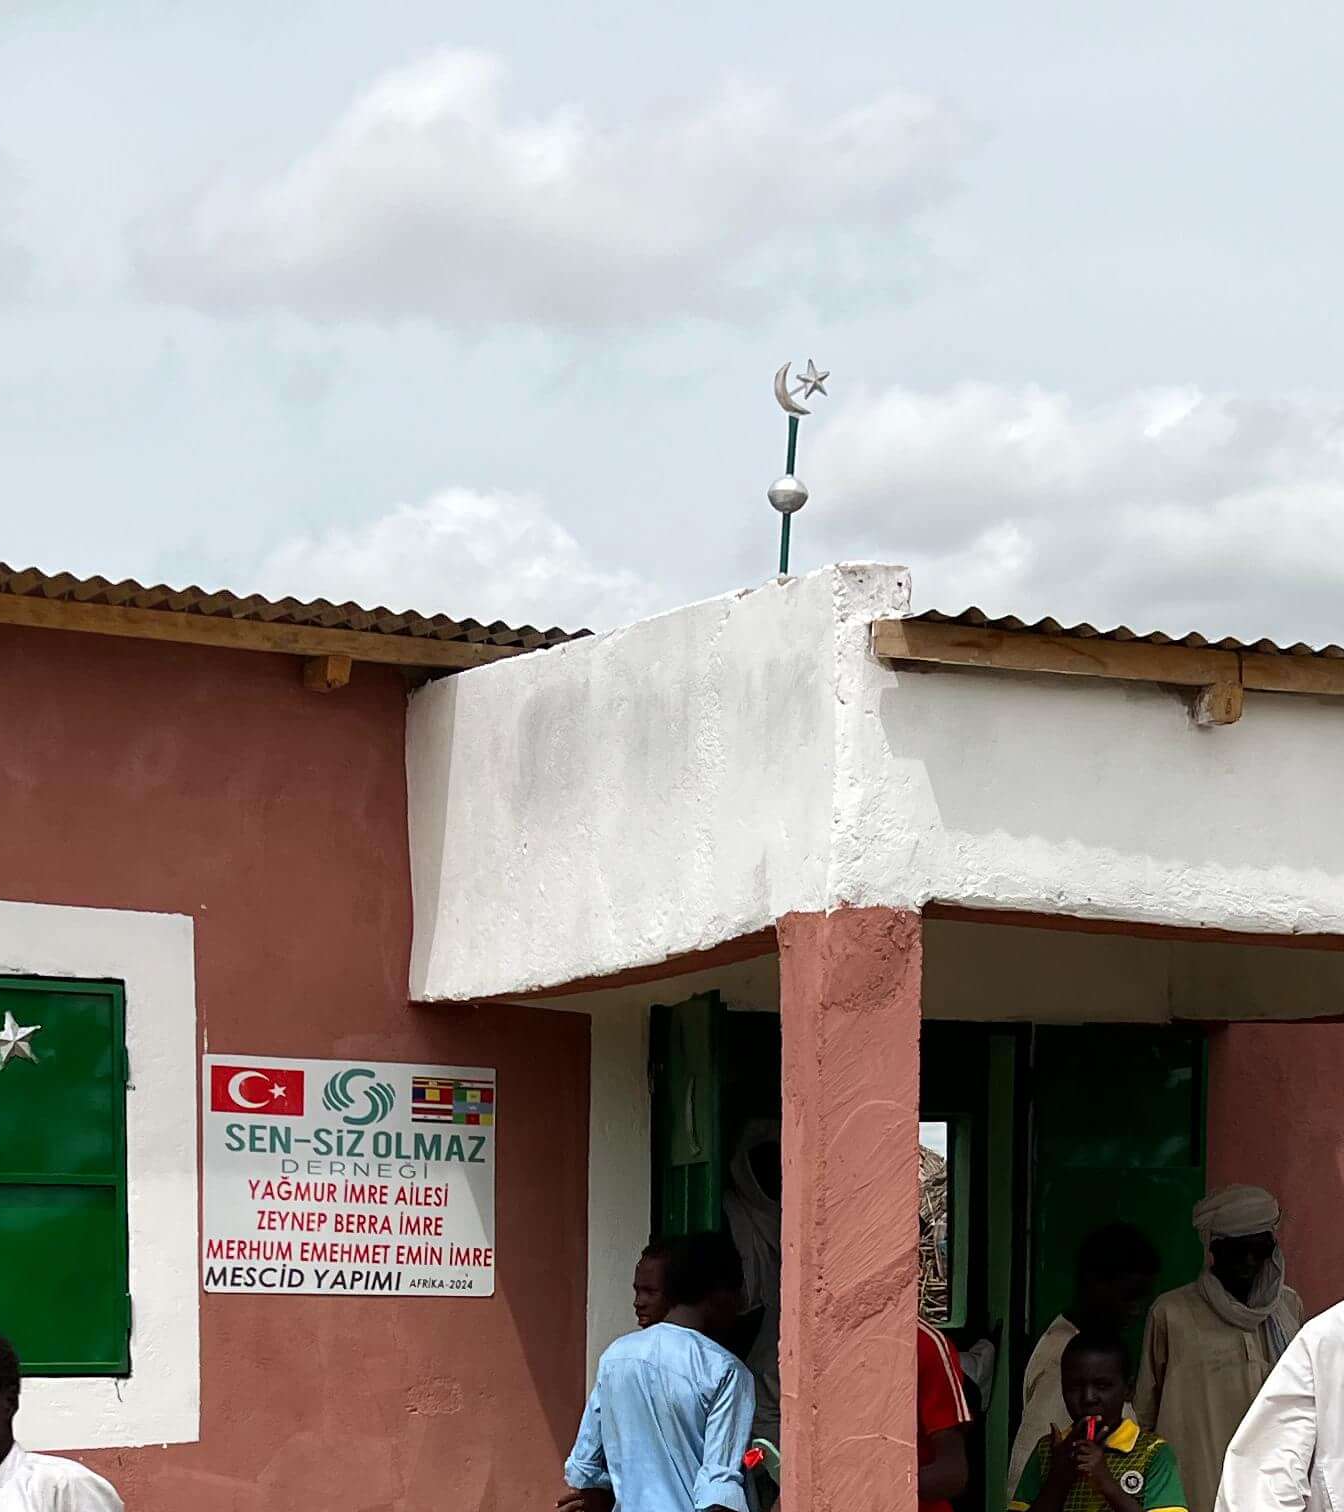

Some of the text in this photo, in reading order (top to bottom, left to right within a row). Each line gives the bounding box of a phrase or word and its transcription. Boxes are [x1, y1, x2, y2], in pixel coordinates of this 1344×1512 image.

[373, 1132, 486, 1163] OLMAZ
[249, 1176, 448, 1207] YAĞMUR İMRE AİLESİ
[257, 1210, 444, 1236] ZEYNEP BERRA İMRE
[206, 1239, 493, 1267] MERHUM EMEHMET EMİN İMRE
[205, 1263, 304, 1289] MESCİD
[315, 1269, 402, 1291] YAPIMI
